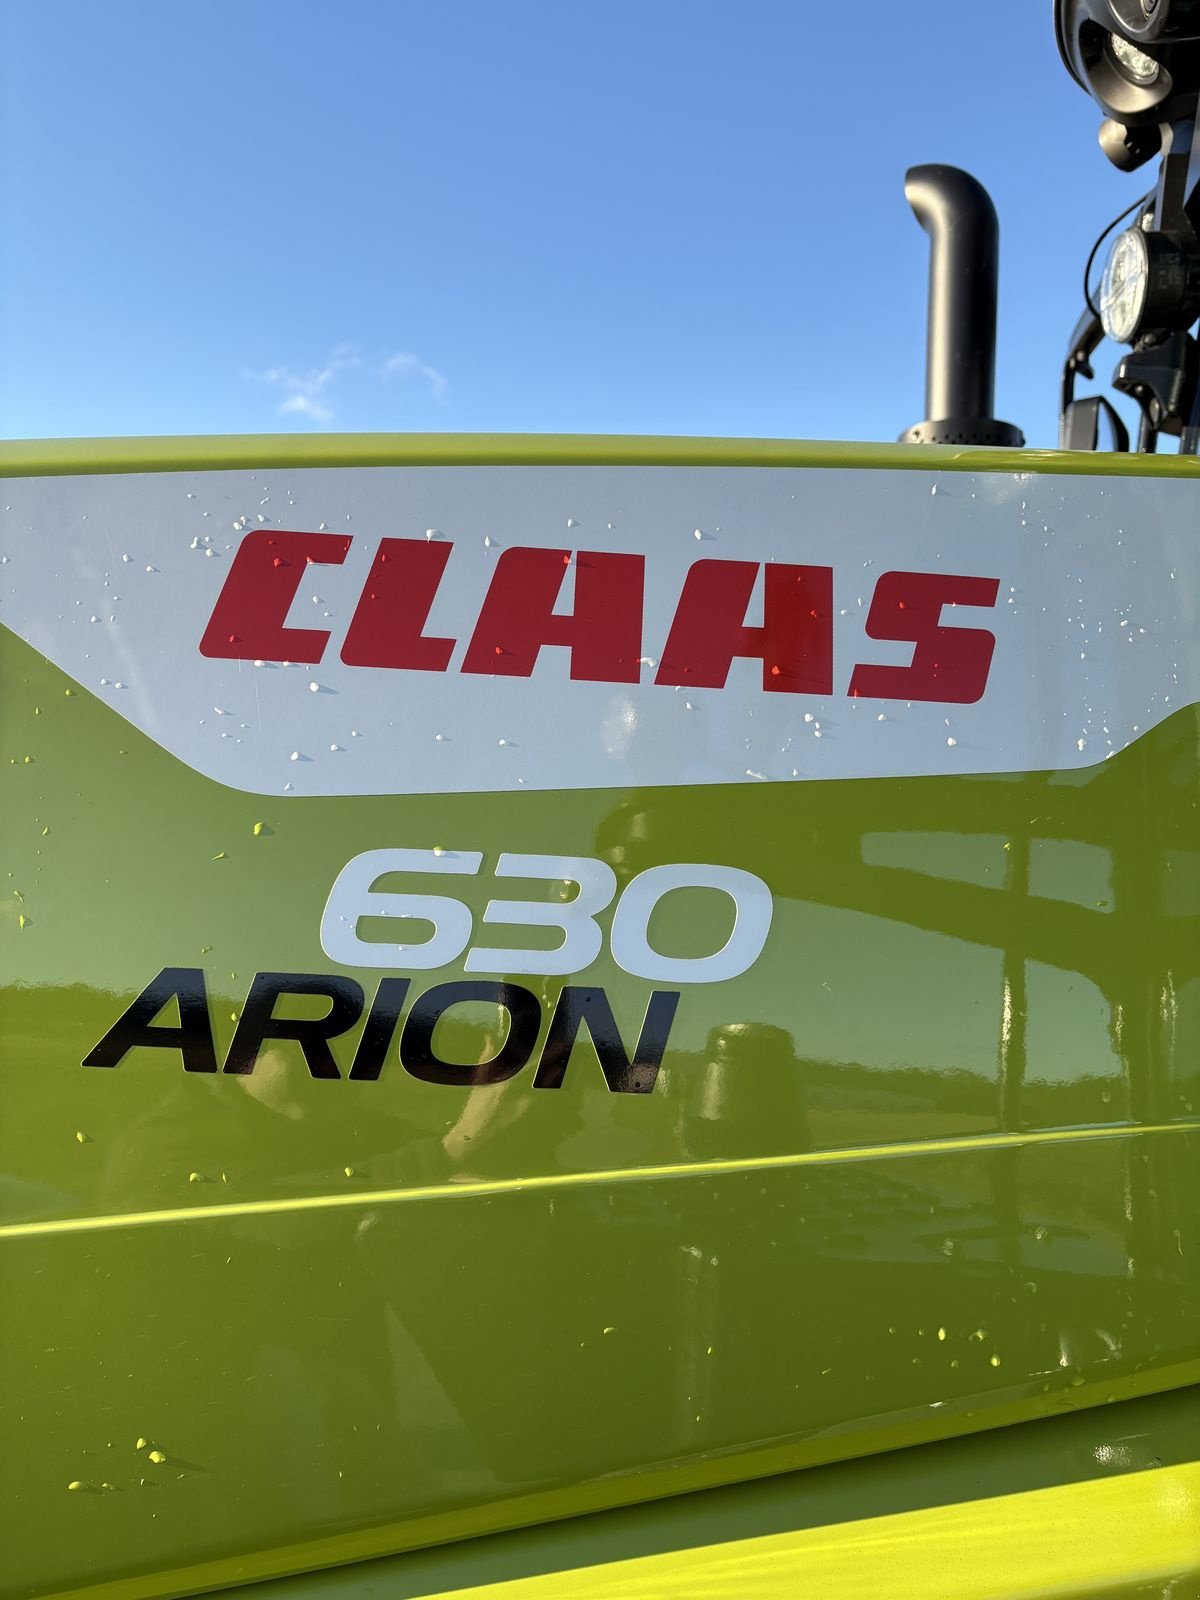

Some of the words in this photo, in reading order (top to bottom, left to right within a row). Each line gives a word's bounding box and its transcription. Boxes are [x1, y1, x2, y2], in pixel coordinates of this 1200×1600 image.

[199, 530, 1000, 704] CLAAS
[320, 848, 773, 983] 630
[82, 968, 680, 1094] ARION
